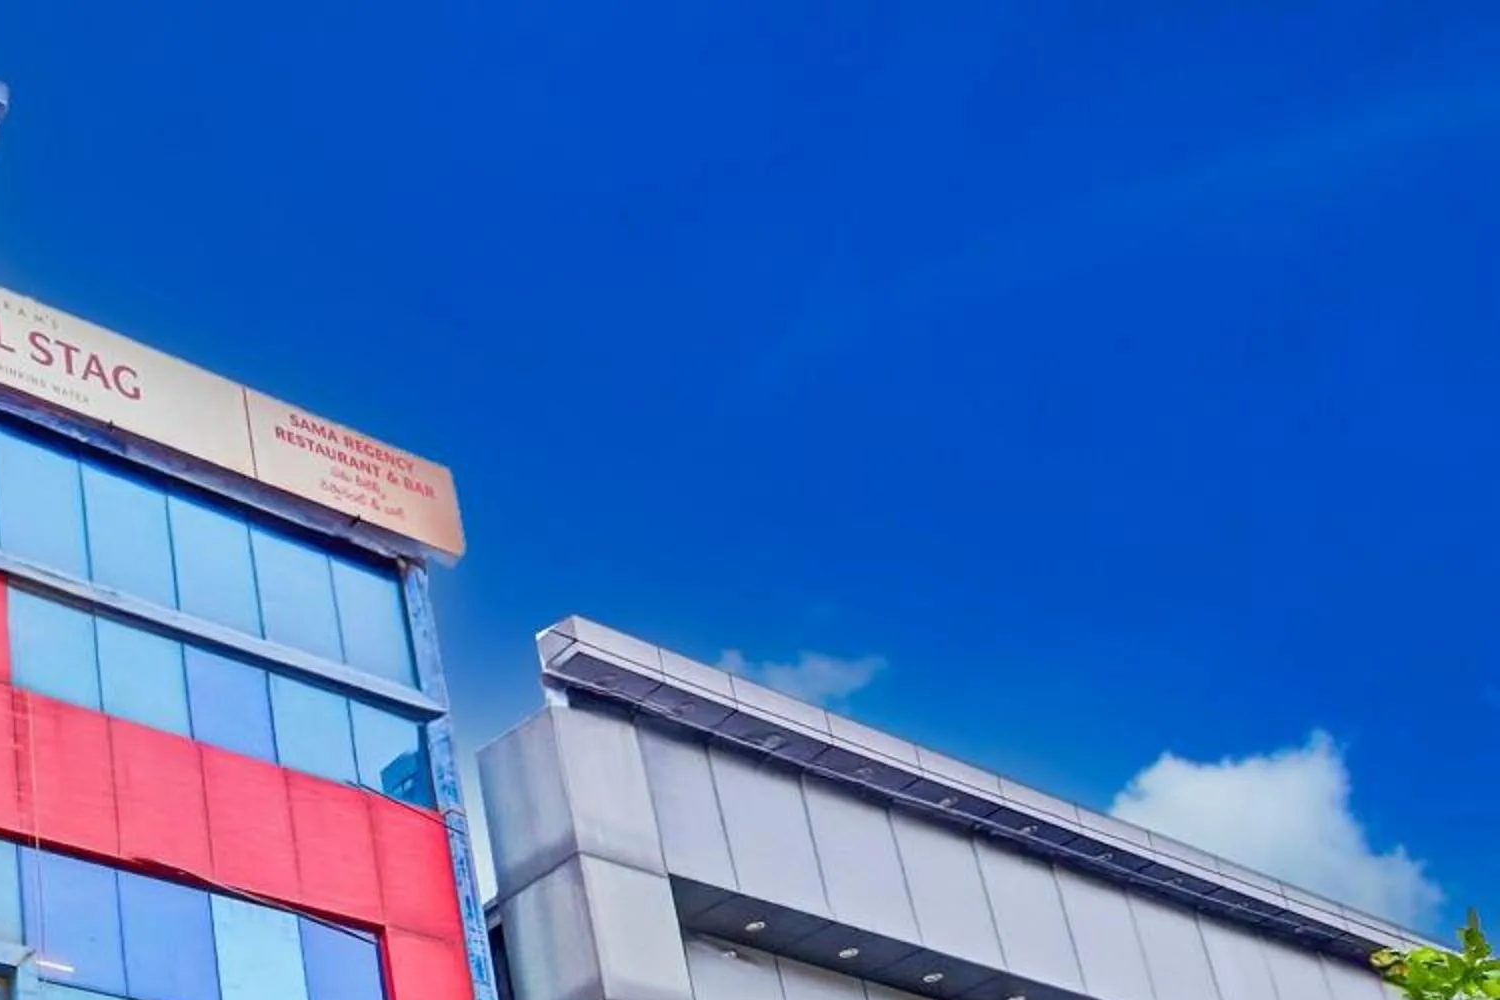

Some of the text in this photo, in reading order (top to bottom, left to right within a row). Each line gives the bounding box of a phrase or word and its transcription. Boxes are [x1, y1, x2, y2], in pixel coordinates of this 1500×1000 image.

[27, 331, 142, 400] STAG
[275, 426, 381, 477] RESTAURANT
[403, 476, 436, 498] BAR
[289, 413, 416, 471] SAMA REGENCY
